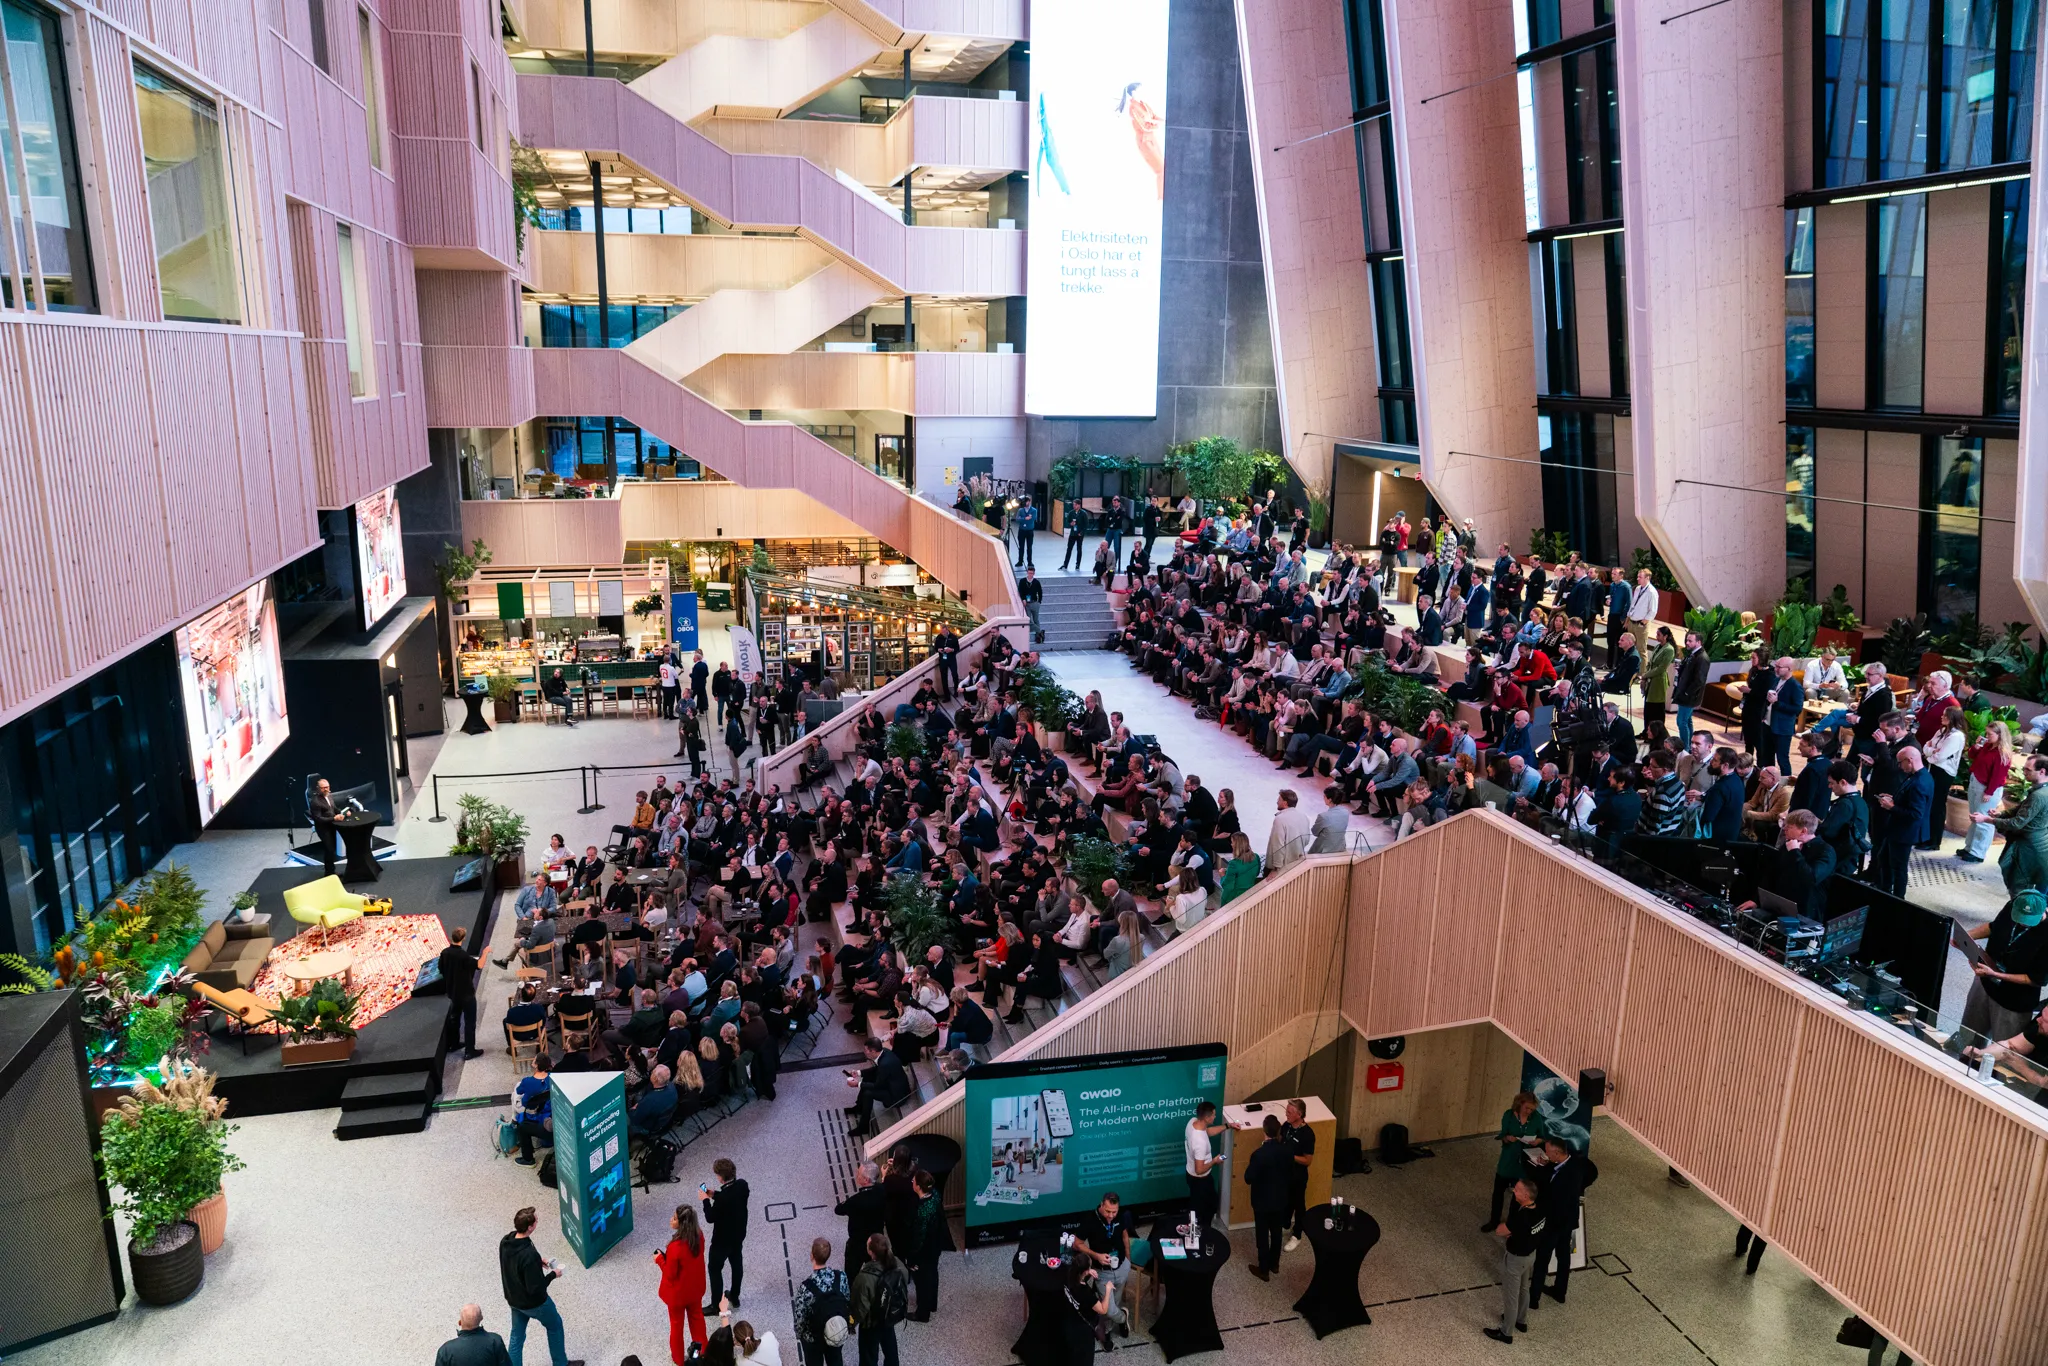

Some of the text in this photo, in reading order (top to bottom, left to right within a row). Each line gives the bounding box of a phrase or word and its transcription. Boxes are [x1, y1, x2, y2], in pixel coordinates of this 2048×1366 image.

[1061, 229, 1148, 244] Elektrisiteten
[1068, 247, 1099, 260] Oslo
[1103, 248, 1123, 260] har
[1128, 250, 1141, 261] et
[1061, 264, 1096, 279] tungt
[1100, 265, 1127, 277] lass
[1061, 281, 1105, 294] trekke.
[1080, 1088, 1122, 1100] awaio
[1080, 1096, 1204, 1116] The All-in-one Platform
[584, 1109, 620, 1138] Futureproofing
[1079, 1120, 1094, 1128] for
[1097, 1115, 1139, 1126] Modern
[589, 1130, 601, 1142] Real
[600, 1120, 616, 1134] Estate
